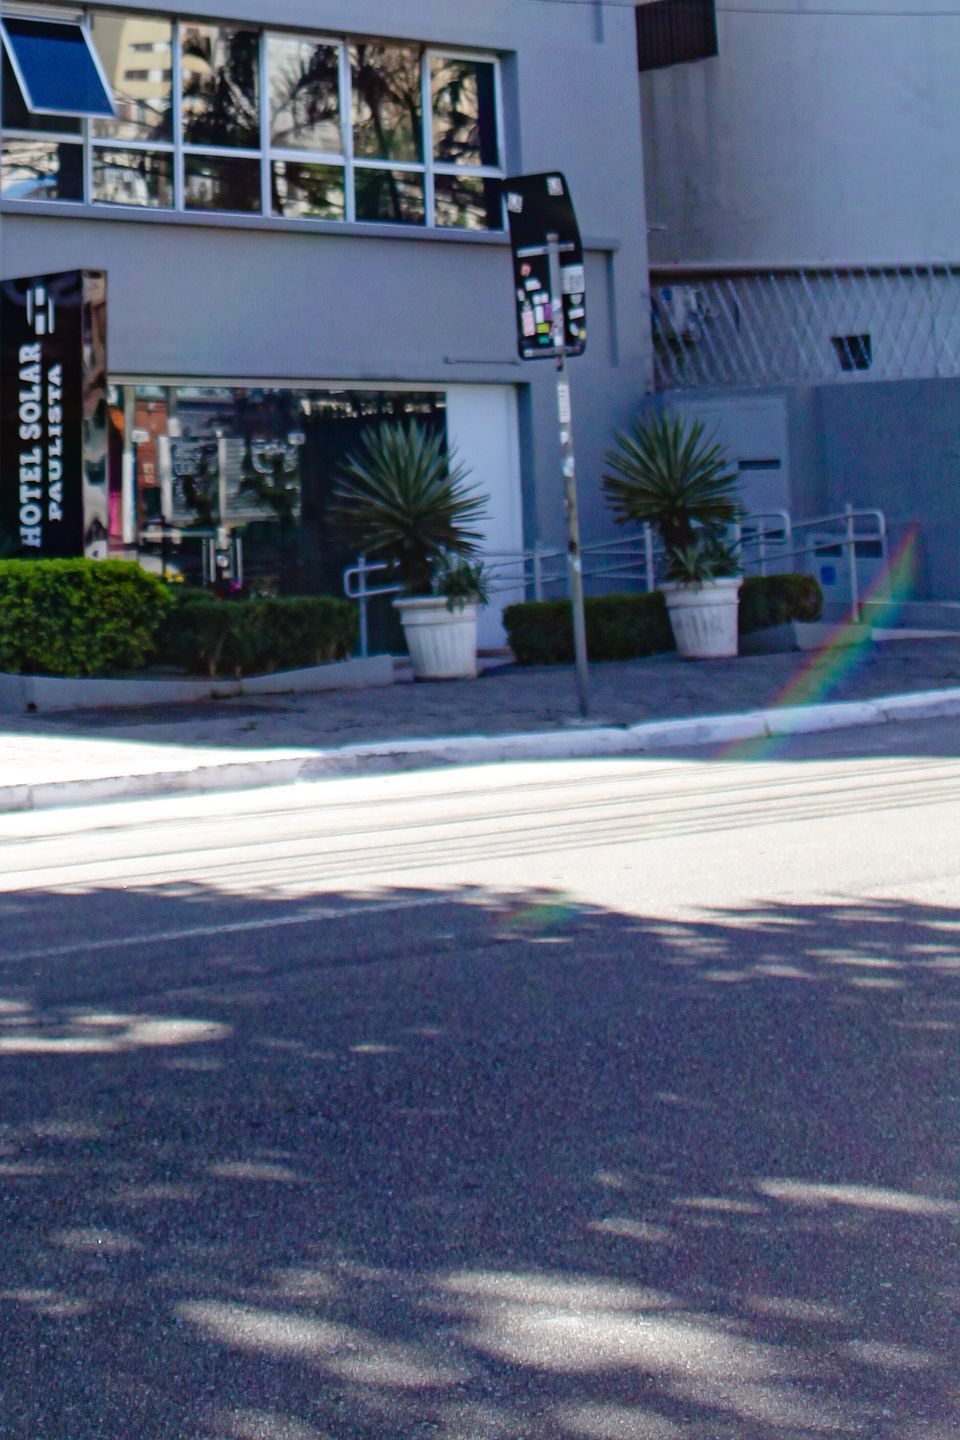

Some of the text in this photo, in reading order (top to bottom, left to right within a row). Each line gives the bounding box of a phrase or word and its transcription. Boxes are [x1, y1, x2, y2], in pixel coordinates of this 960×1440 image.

[19, 342, 42, 548] HOTEL SOLAR
[48, 363, 64, 523] PAULISTA
